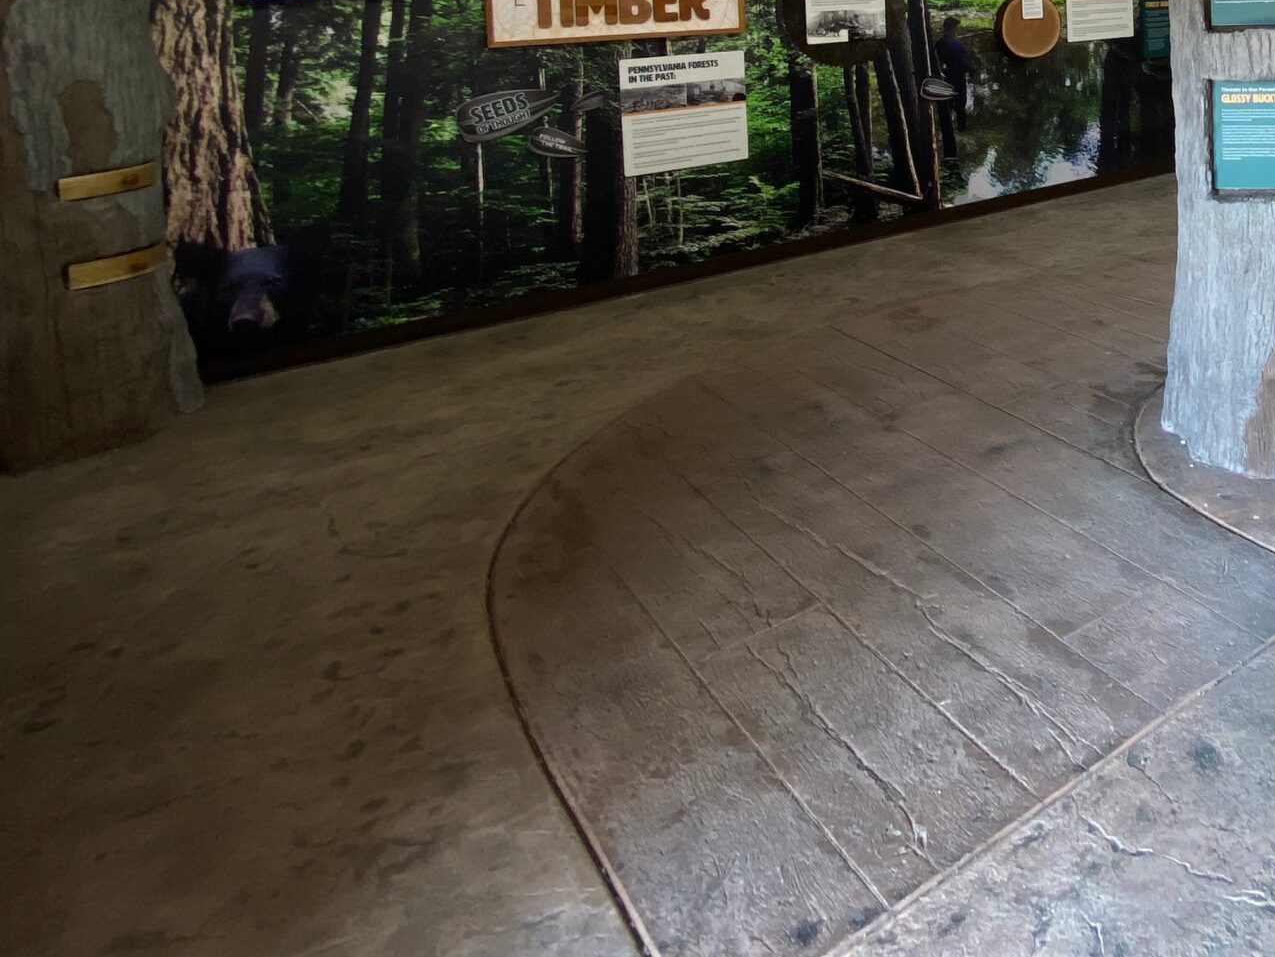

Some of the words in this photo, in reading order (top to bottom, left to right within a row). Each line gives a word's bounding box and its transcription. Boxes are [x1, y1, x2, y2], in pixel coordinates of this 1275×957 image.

[628, 62, 687, 75] PENNSYLVANIA
[687, 59, 719, 69] FORESTS
[628, 75, 638, 84] IN
[639, 73, 654, 83] THE
[655, 71, 676, 82] PAST:
[1221, 94, 1251, 103] GLOSSY
[469, 92, 530, 125] SEEDS
[476, 121, 491, 135] OF
[490, 109, 531, 133] THOUGHT
[539, 133, 566, 145] FOLLOW
